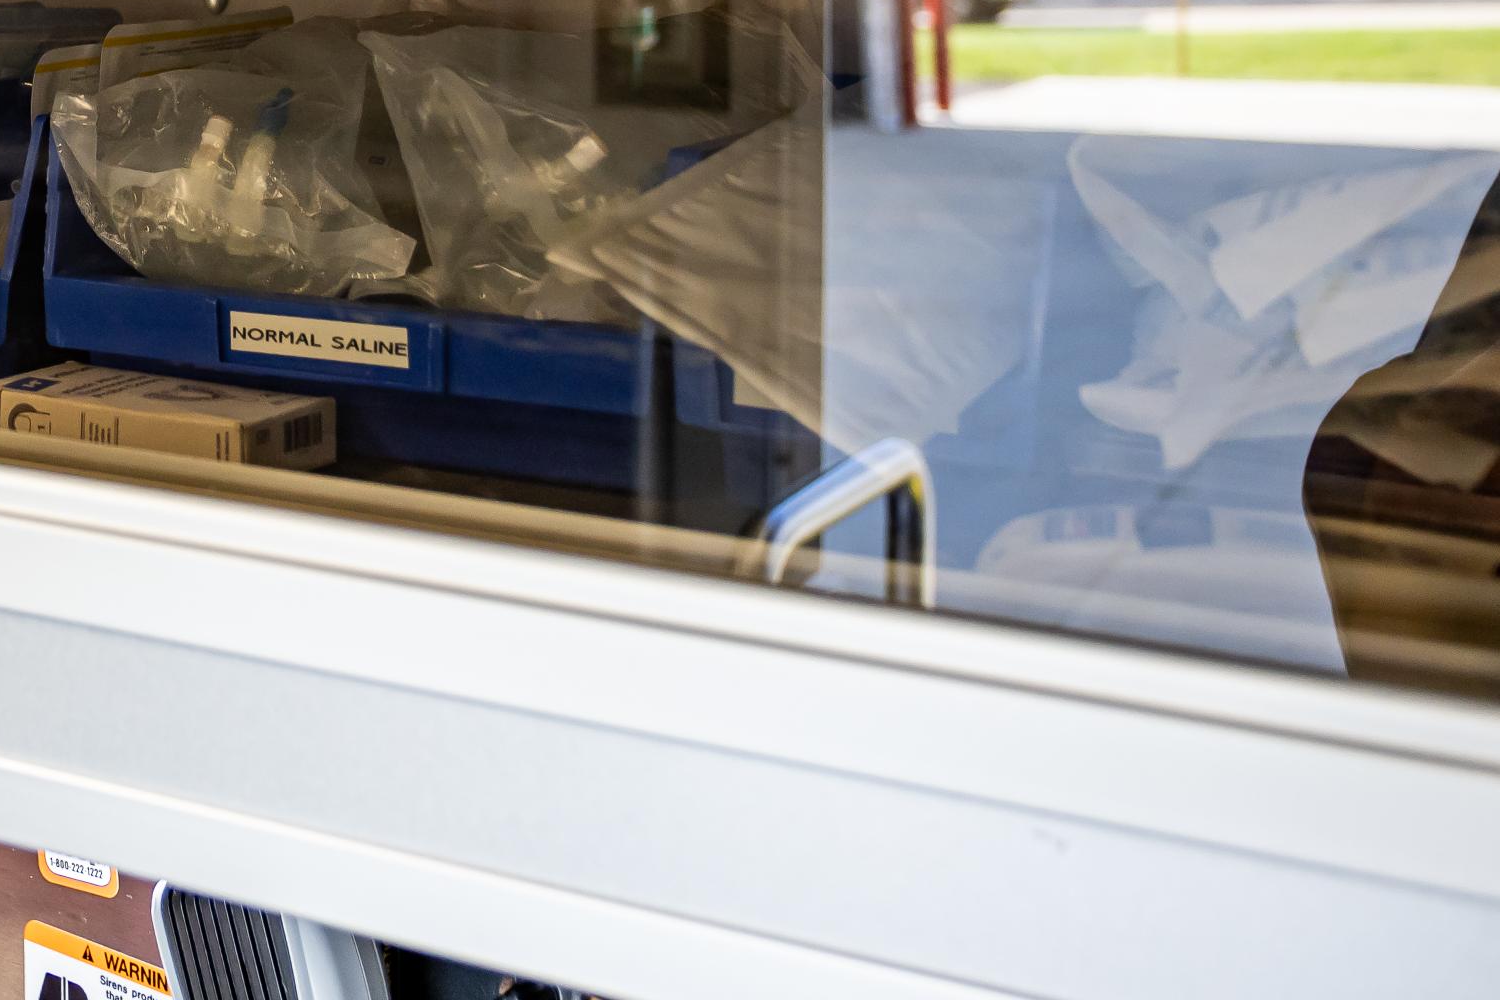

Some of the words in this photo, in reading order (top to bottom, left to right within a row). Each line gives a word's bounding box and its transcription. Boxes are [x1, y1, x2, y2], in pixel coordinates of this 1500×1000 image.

[232, 326, 321, 348] NORMAL
[331, 336, 407, 357] SALINE
[50, 857, 103, 879] 1-800-222-1222
[100, 975, 128, 994] Sirens
[104, 951, 169, 992] WARNIN
